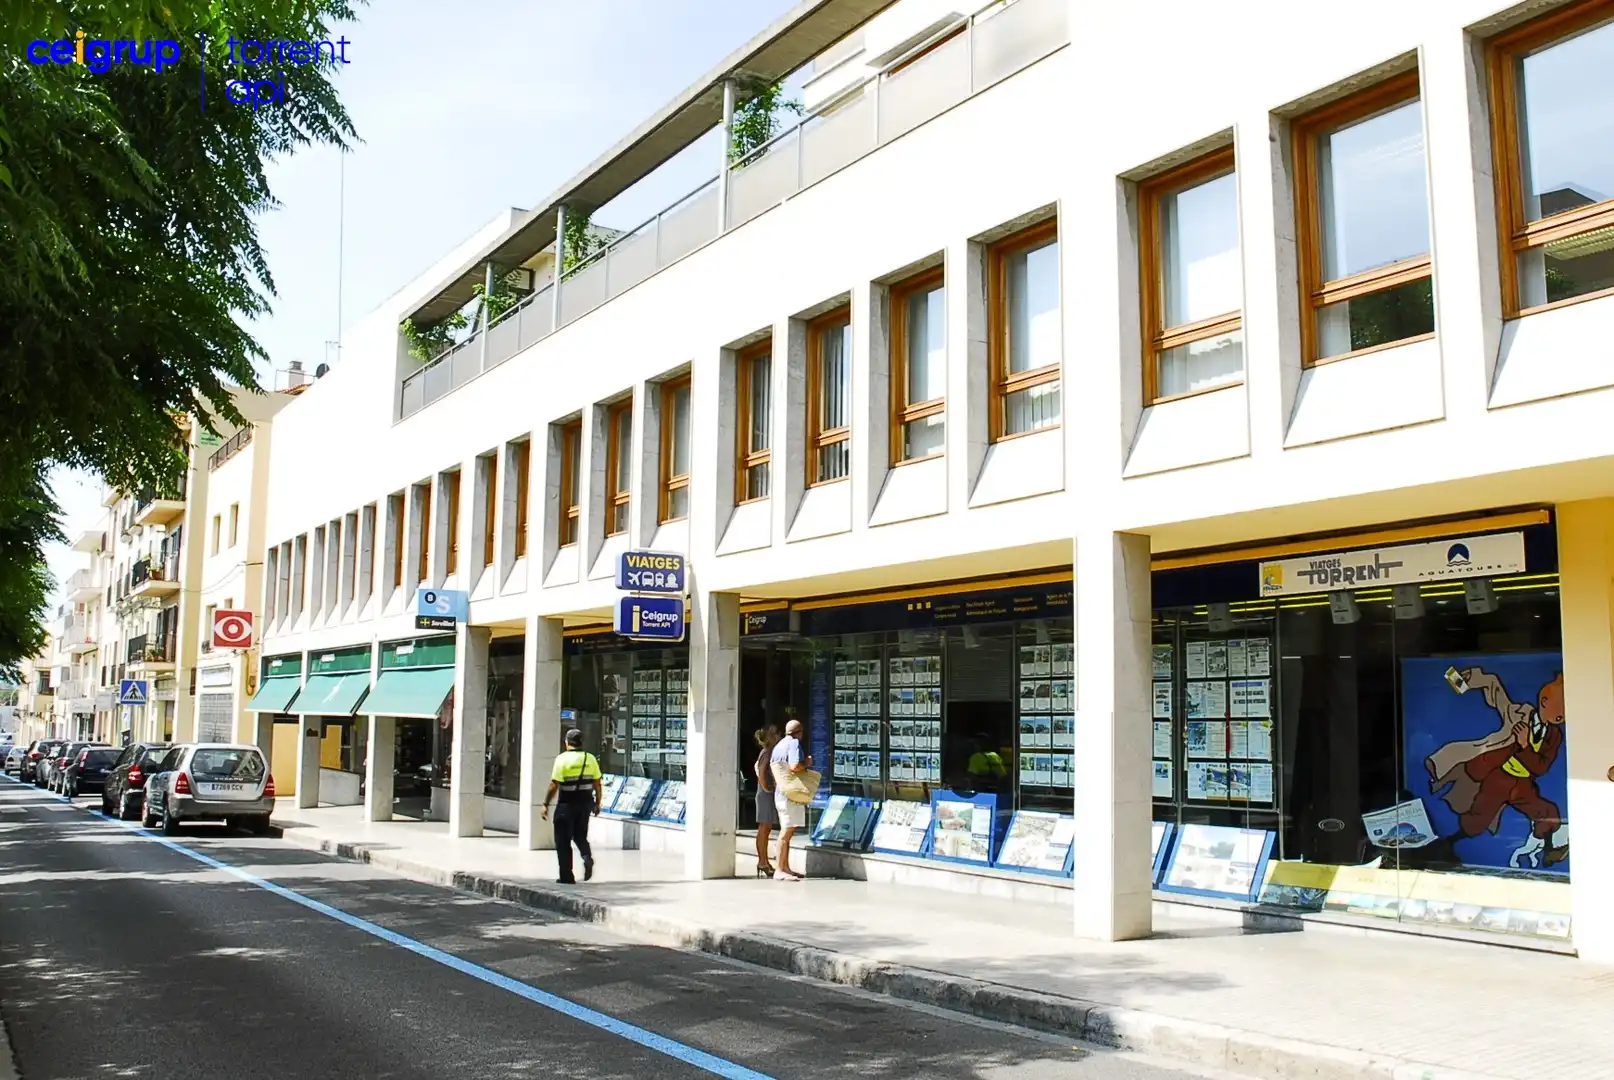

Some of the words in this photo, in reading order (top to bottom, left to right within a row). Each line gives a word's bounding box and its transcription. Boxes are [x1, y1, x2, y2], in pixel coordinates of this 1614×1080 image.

[626, 555, 680, 570] VIATGES
[1297, 553, 1403, 587] TORRENT
[1309, 558, 1342, 570] VIATGES
